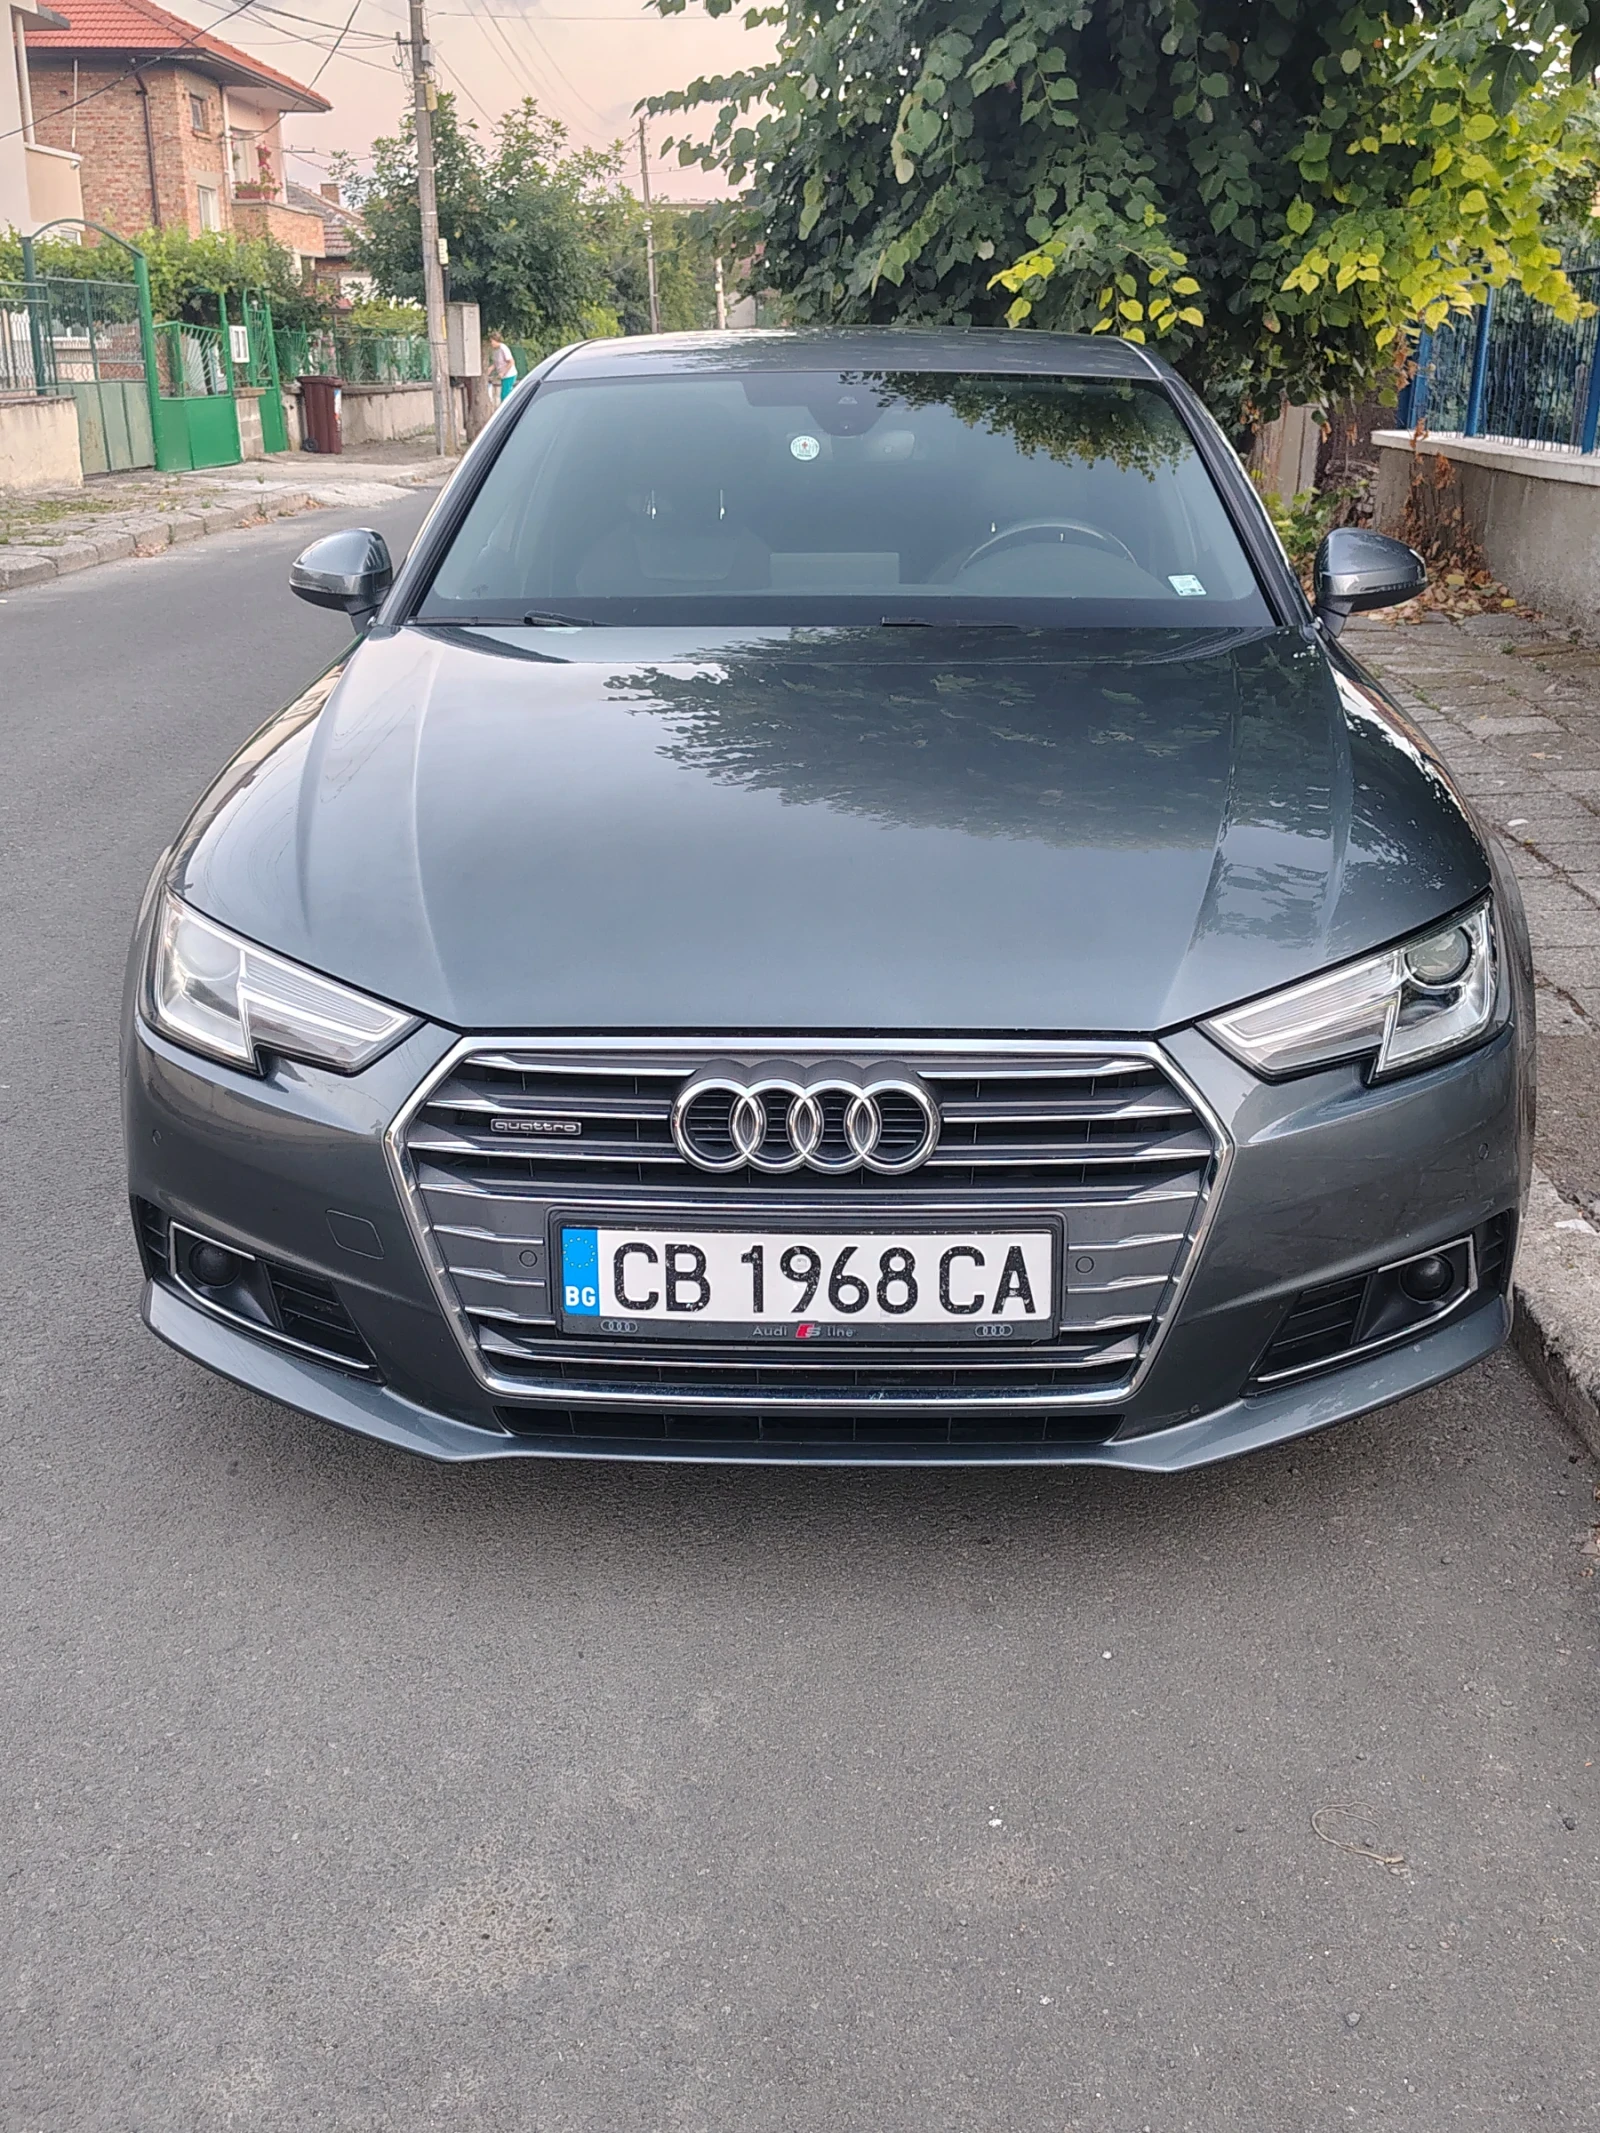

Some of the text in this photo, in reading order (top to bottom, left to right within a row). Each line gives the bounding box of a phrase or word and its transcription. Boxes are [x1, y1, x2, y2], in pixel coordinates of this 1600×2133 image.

[495, 1121, 577, 1132] quattro
[613, 1242, 1036, 1314] CB 1968 CA
[565, 1285, 596, 1307] BG
[753, 1326, 788, 1336] Audi
[827, 1326, 853, 1337] line
